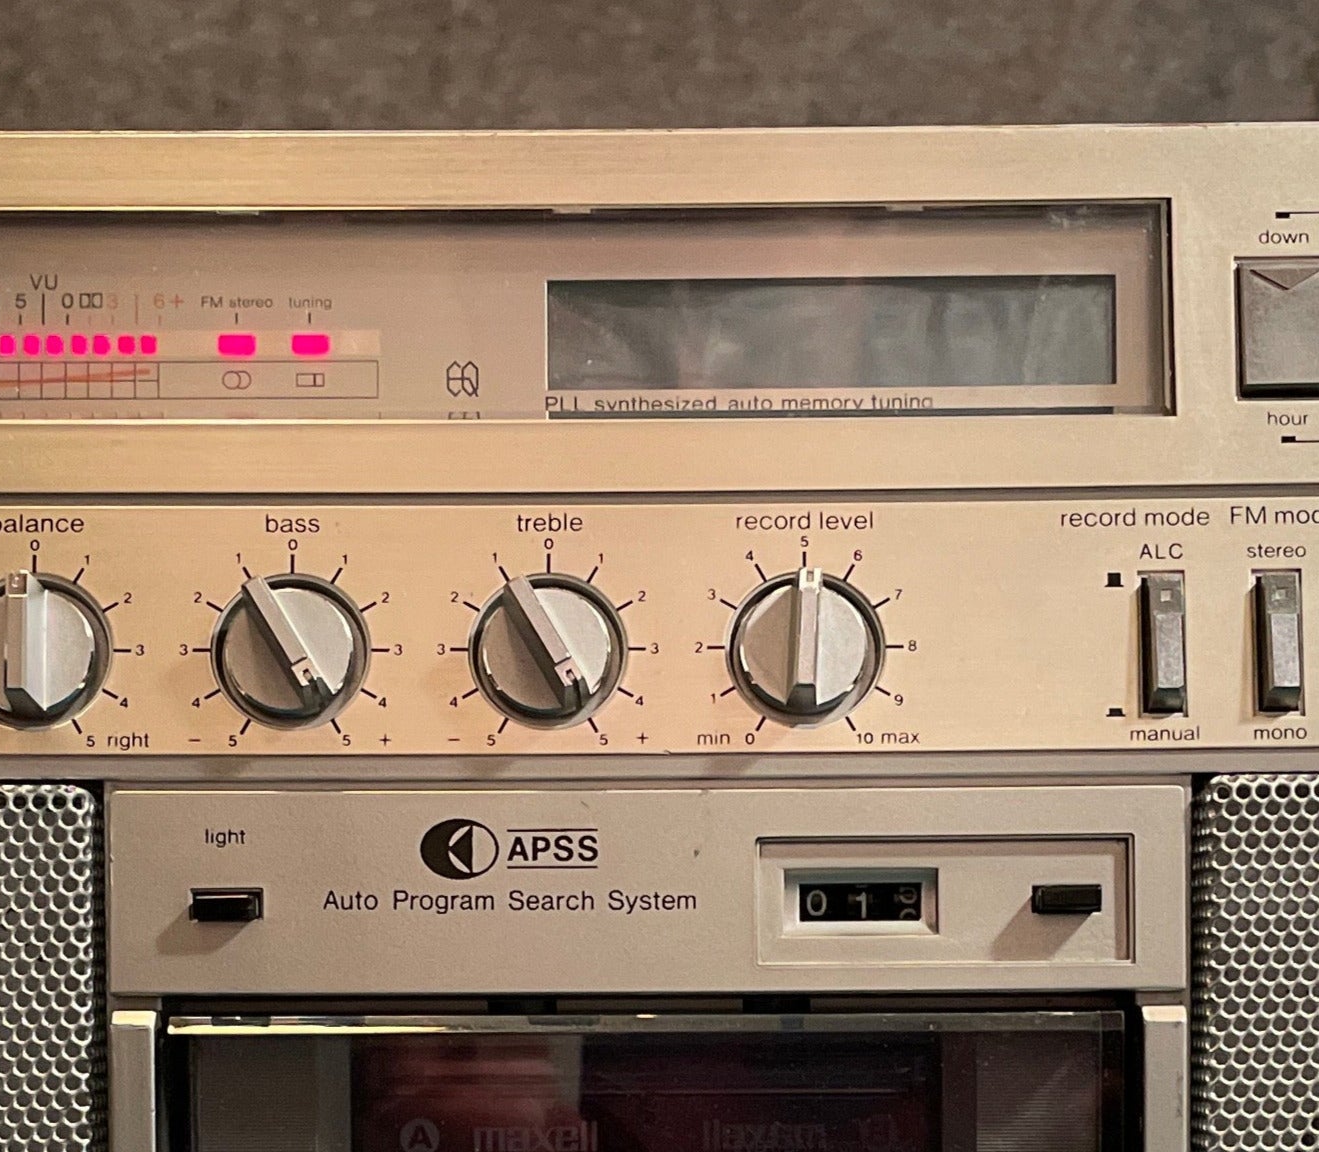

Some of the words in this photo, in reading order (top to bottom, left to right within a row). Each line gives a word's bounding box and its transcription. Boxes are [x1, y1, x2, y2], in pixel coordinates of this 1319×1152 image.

[1259, 230, 1309, 244] down
[30, 274, 57, 291] VU
[15, 293, 27, 309] 5
[62, 293, 74, 309] 0
[201, 296, 223, 308] FM
[229, 297, 273, 308] stereo
[289, 297, 332, 310] tuning
[544, 395, 583, 411] PLL
[594, 394, 718, 411] synthesized
[727, 394, 774, 411] auto
[782, 395, 864, 411] memory
[871, 393, 933, 409] tuning
[1268, 412, 1308, 426] hour
[737, 512, 810, 530] record
[820, 511, 873, 530] level
[1061, 508, 1135, 527] record
[1145, 507, 1209, 526] mode
[1231, 506, 1266, 524] FM
[266, 514, 319, 533] bass
[517, 513, 582, 532] treble
[30, 539, 40, 551] 0
[288, 539, 297, 550] 0
[544, 538, 554, 550] 0
[801, 536, 808, 547] 5
[746, 551, 753, 561] 4
[854, 550, 862, 561] 6
[1140, 543, 1183, 559] ALC
[1247, 544, 1306, 558] stereo
[124, 592, 131, 603] 2
[194, 592, 202, 603] 2
[382, 592, 389, 603] 2
[708, 589, 716, 600] 3
[896, 589, 902, 600] 7
[136, 644, 144, 656] 3
[180, 644, 188, 656] 3
[394, 644, 402, 656] 3
[695, 642, 703, 653] 2
[908, 640, 917, 651] 8
[600, 734, 608, 745] 5
[697, 734, 730, 745] min
[745, 733, 755, 745] 0
[857, 733, 873, 744] 10
[881, 733, 919, 744] max
[1130, 727, 1199, 741] manual
[1254, 728, 1307, 740] mono
[87, 736, 95, 747] 5
[108, 732, 149, 751] right
[229, 735, 237, 747] 5
[343, 735, 351, 746] 5
[487, 735, 495, 746] 5
[205, 829, 245, 848] light
[507, 835, 598, 861] APSS
[324, 890, 378, 910] Auto
[393, 890, 494, 914] Program
[509, 890, 594, 911] Search
[608, 890, 696, 914] System
[473, 1121, 598, 1152] maxell
